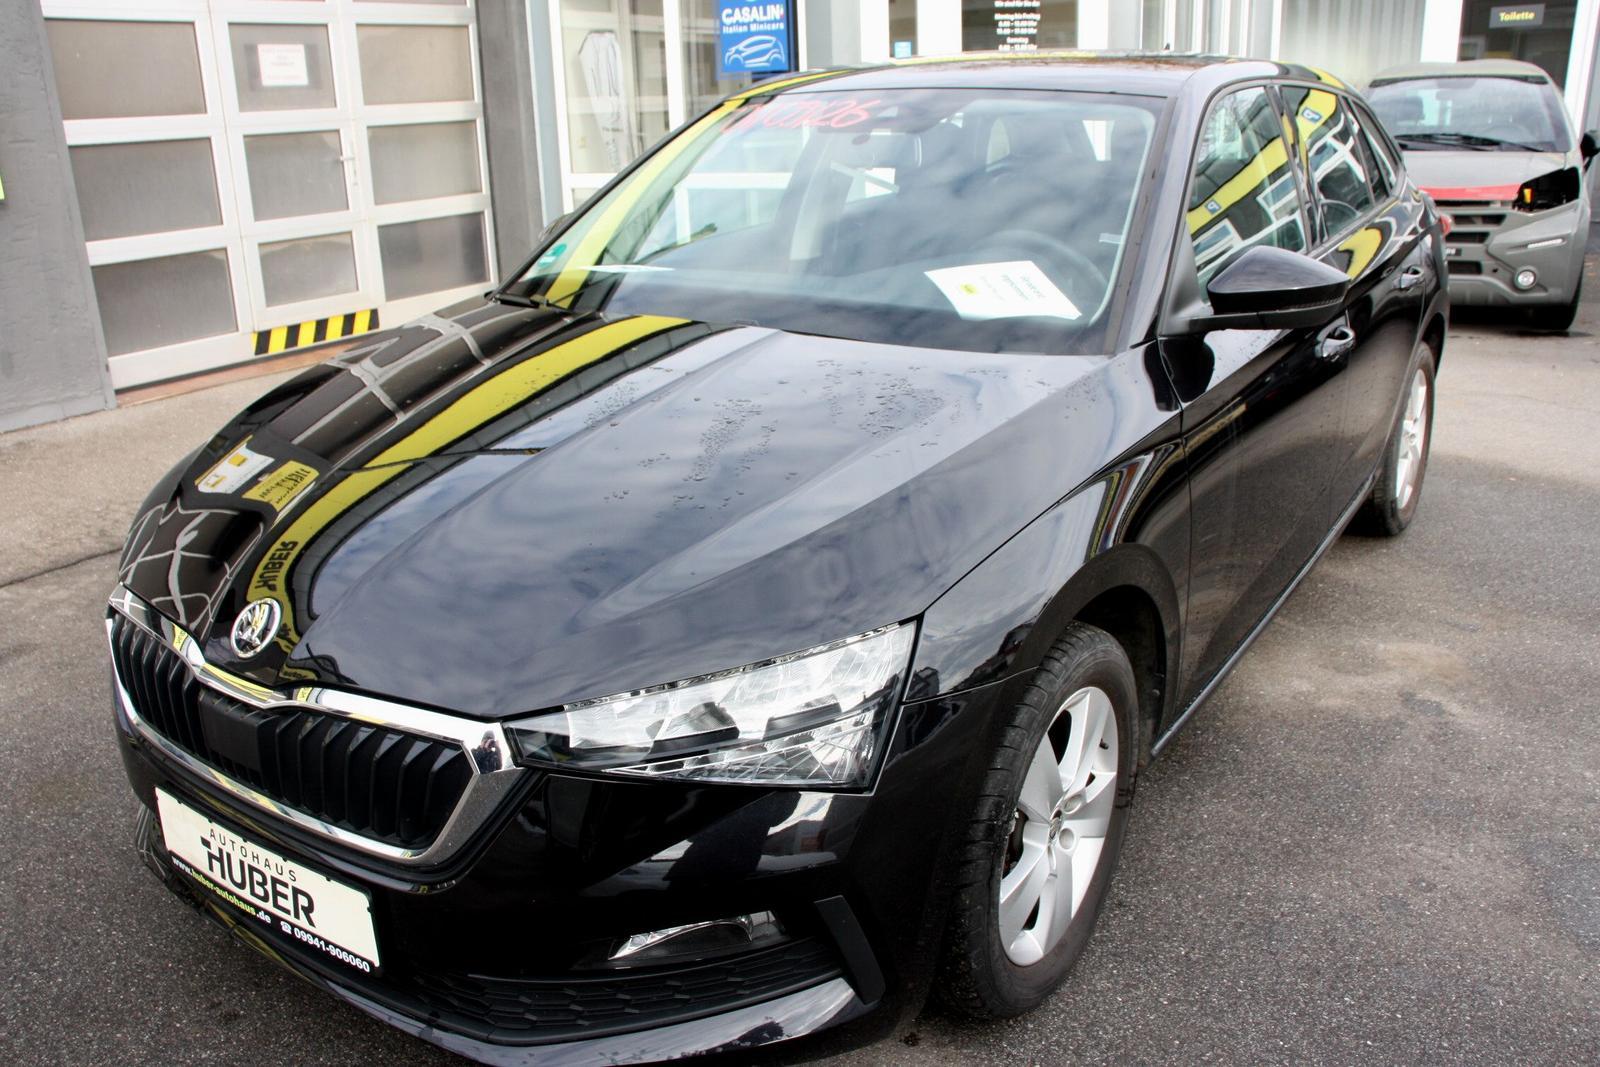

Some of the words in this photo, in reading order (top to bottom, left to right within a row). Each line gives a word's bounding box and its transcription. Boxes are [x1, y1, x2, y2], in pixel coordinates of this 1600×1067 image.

[722, 24, 749, 34] Italian
[750, 22, 785, 32] Minicars
[1499, 11, 1535, 22] Toilette
[209, 828, 297, 882] AUTOHAUS
[201, 836, 317, 928] HUBER
[293, 926, 371, 973] 09941-906060
